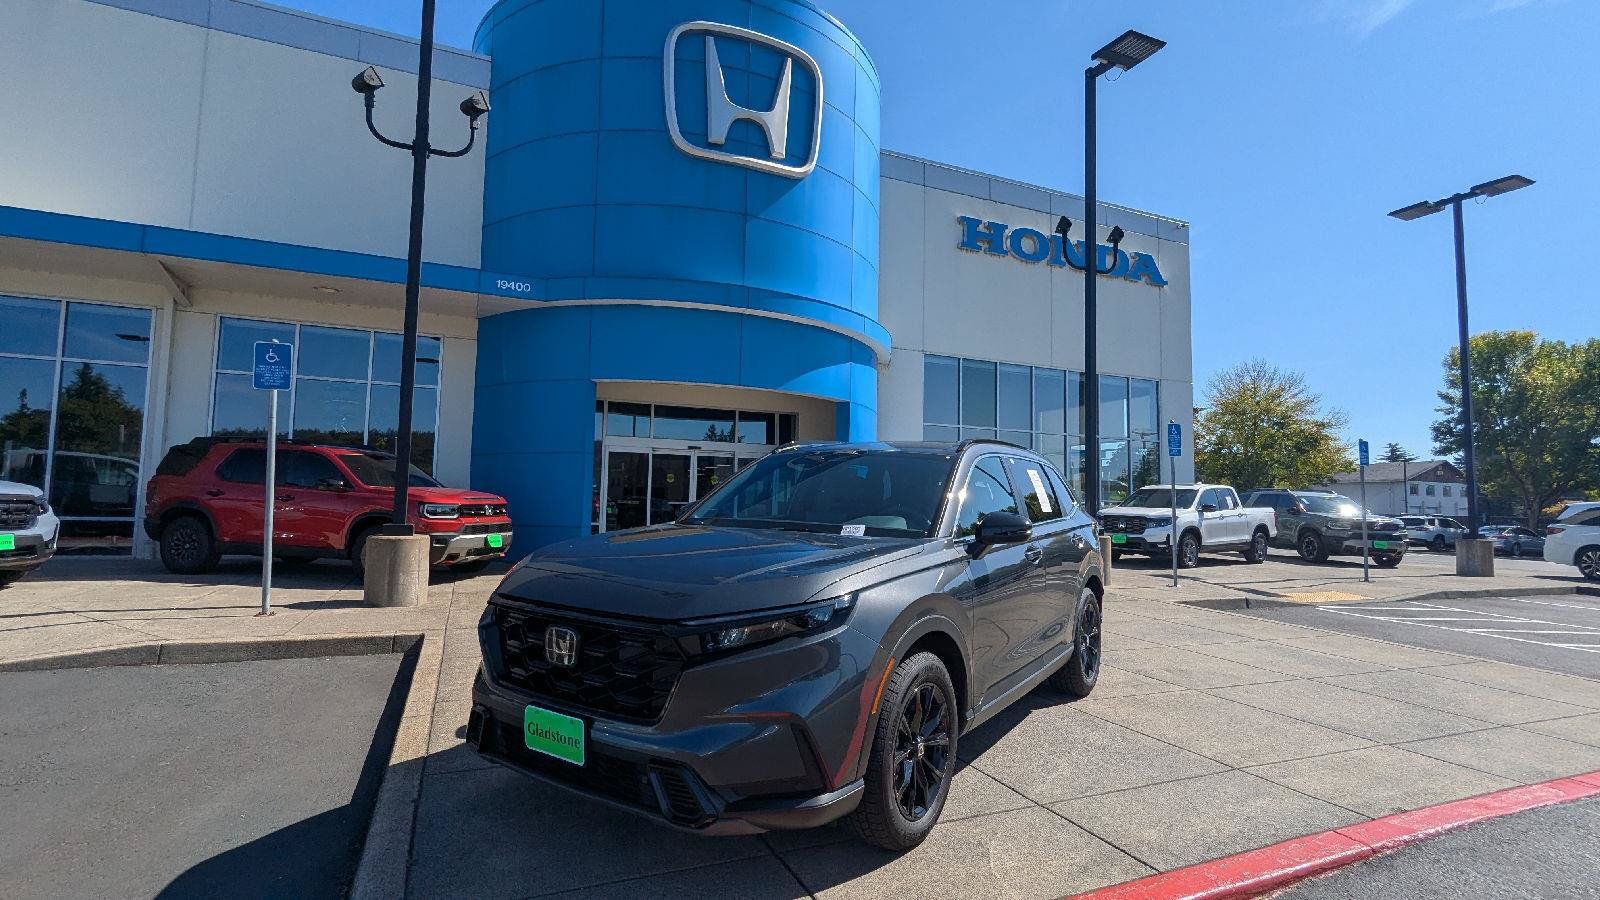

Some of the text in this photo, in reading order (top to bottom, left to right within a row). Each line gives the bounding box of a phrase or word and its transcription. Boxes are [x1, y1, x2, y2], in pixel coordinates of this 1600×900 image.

[957, 214, 1169, 287] HONDA
[496, 280, 531, 292] 19400
[527, 721, 581, 749] Gladstone
